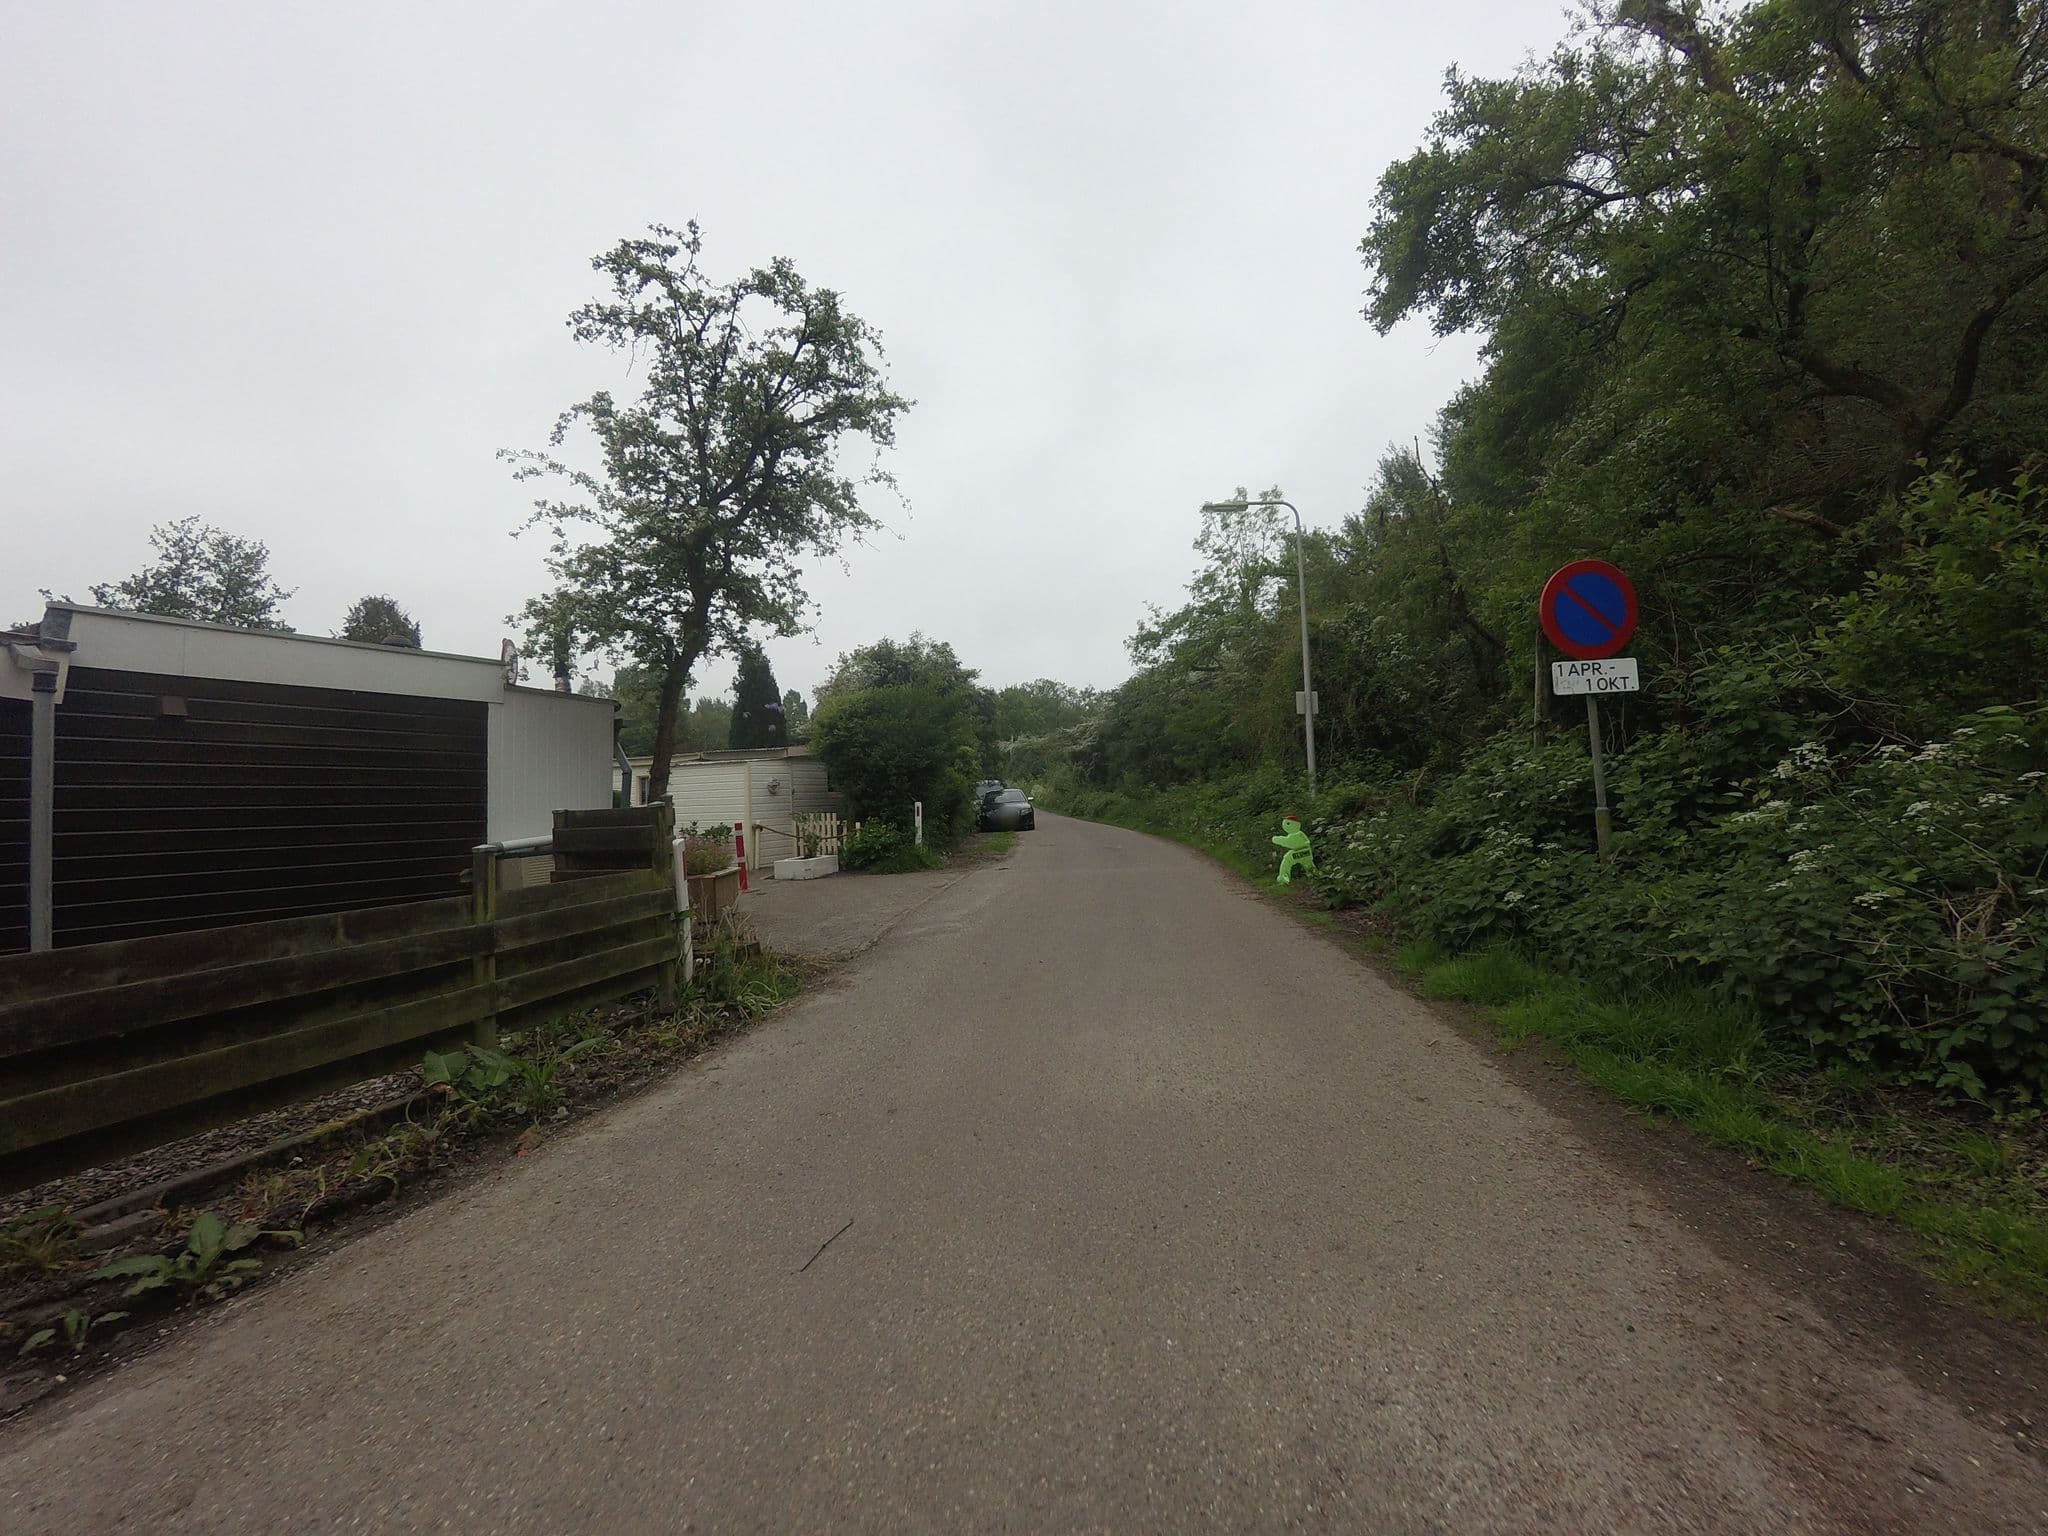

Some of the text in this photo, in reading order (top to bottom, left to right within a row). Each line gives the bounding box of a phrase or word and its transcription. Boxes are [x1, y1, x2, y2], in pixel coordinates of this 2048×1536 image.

[1557, 664, 1563, 677] 1
[1586, 676, 1635, 692] 1 OKT.
